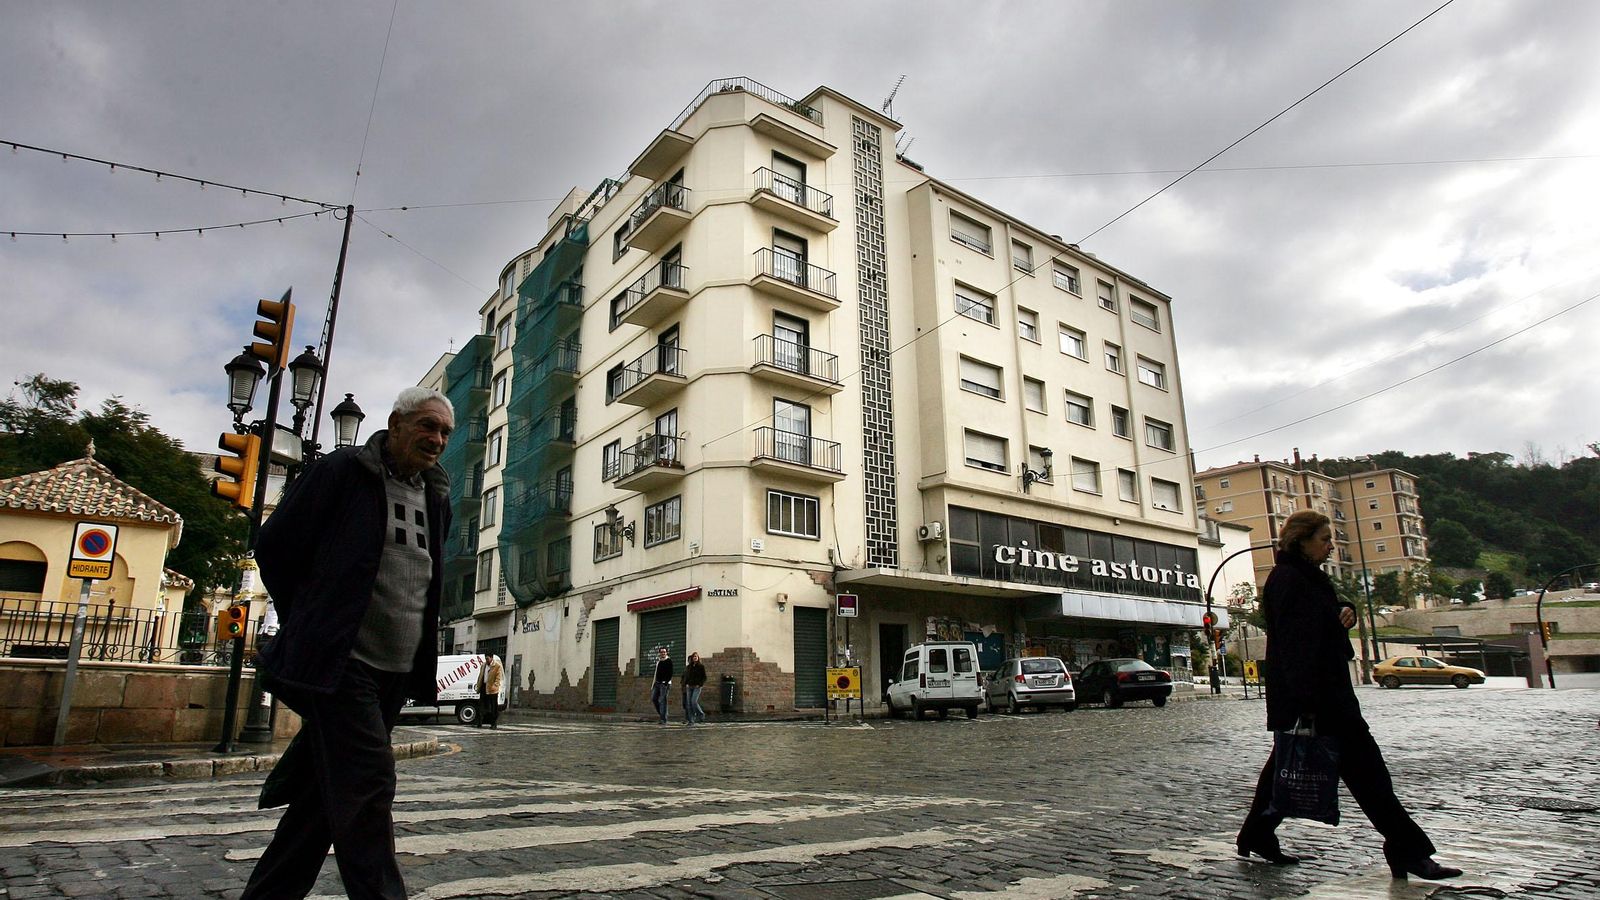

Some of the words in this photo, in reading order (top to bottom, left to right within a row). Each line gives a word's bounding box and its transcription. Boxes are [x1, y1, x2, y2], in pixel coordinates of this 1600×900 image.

[71, 564, 109, 574] HIDRANTE
[993, 540, 1079, 572] cine
[1089, 558, 1201, 589] astoria
